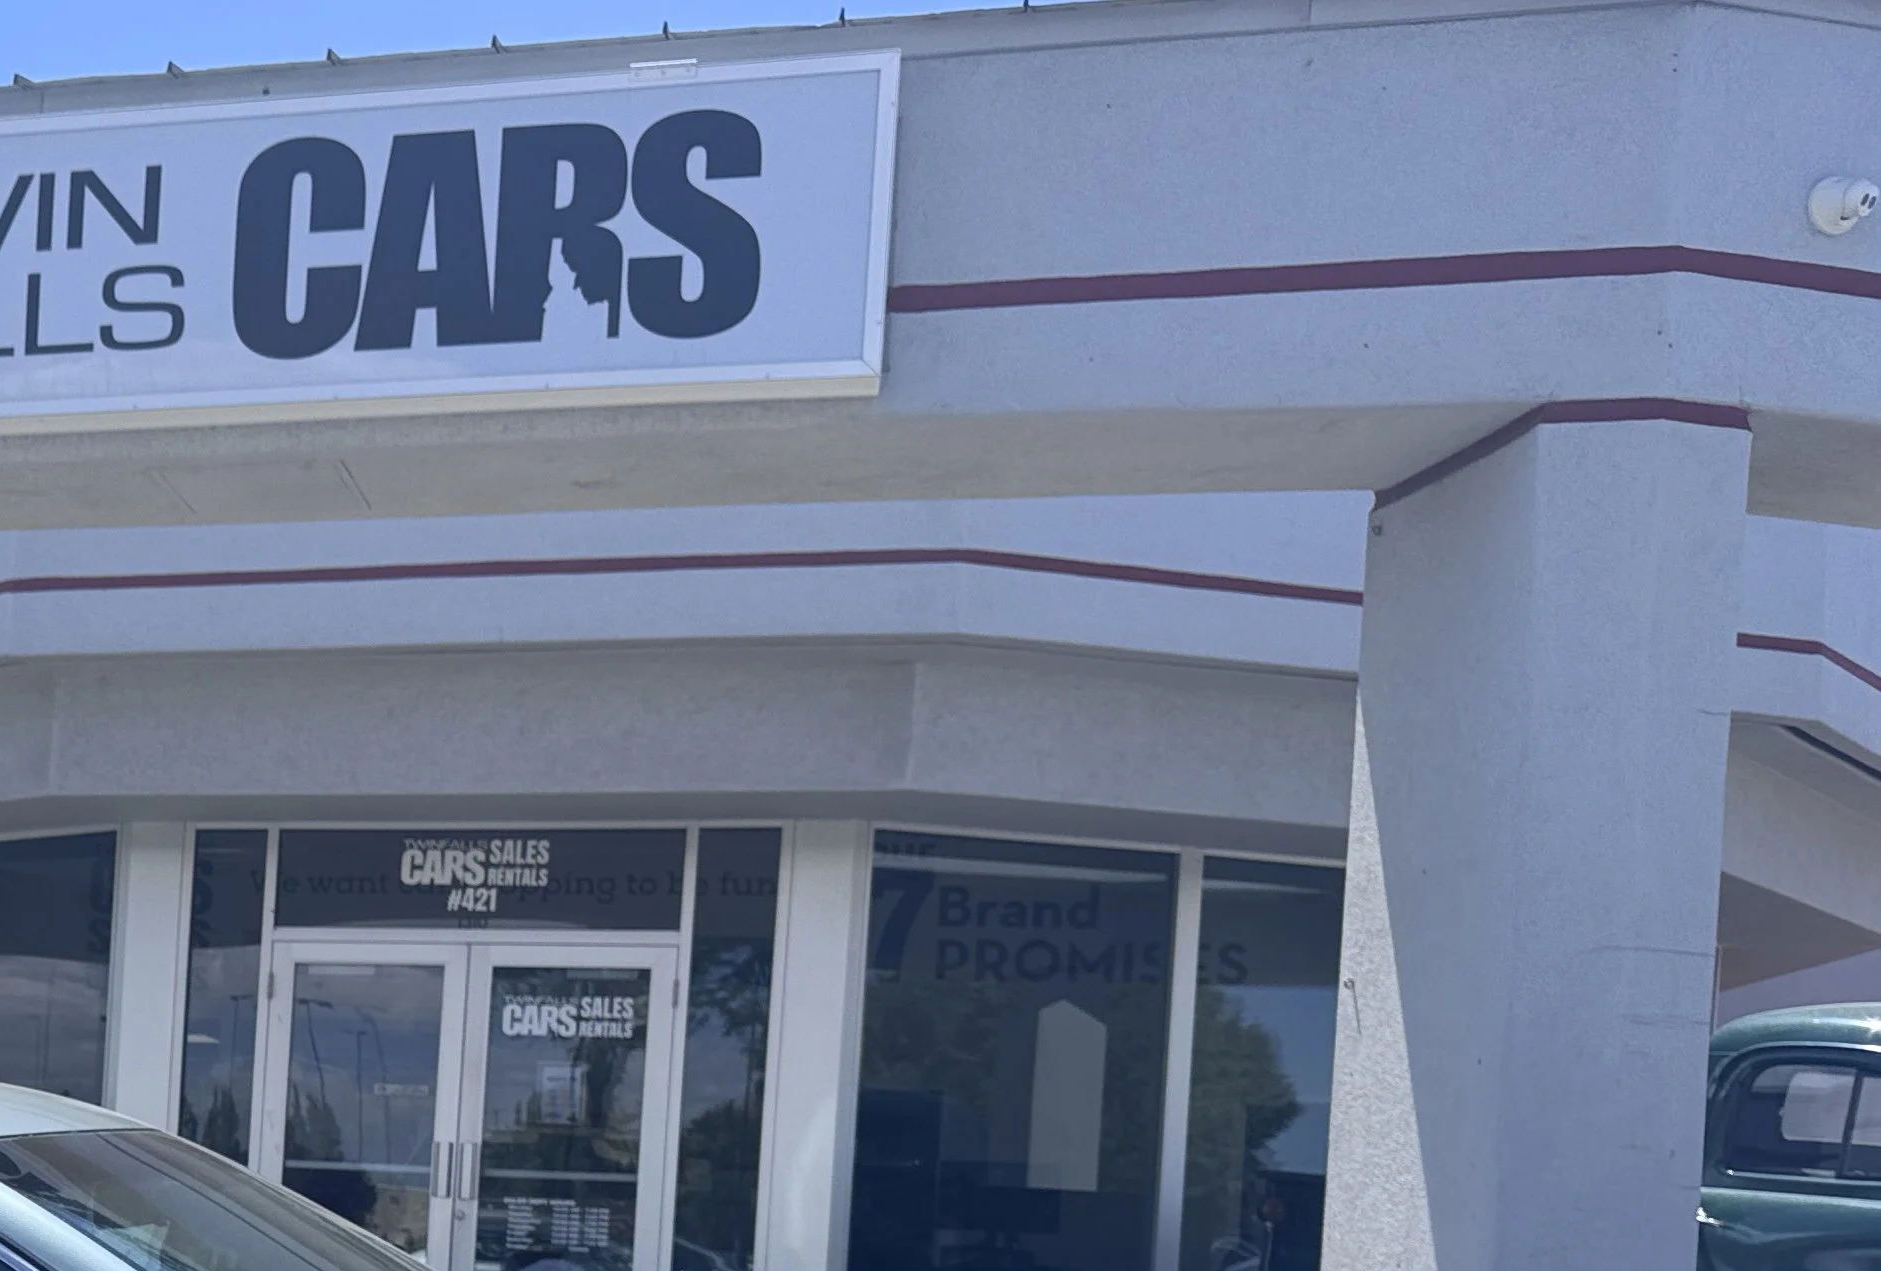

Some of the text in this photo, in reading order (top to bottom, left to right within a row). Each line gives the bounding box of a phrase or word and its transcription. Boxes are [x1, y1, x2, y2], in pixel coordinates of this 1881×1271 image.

[231, 109, 763, 361] CARS
[489, 839, 551, 865] SALES
[400, 849, 486, 886] CARS
[487, 867, 550, 887] RENTALS
[307, 871, 389, 895] want
[626, 872, 660, 897] to
[447, 887, 499, 912] #421
[936, 883, 1101, 930] Brand
[580, 996, 635, 1018] SALES
[502, 1004, 577, 1037] CARS
[579, 1021, 633, 1039] RENTALS
